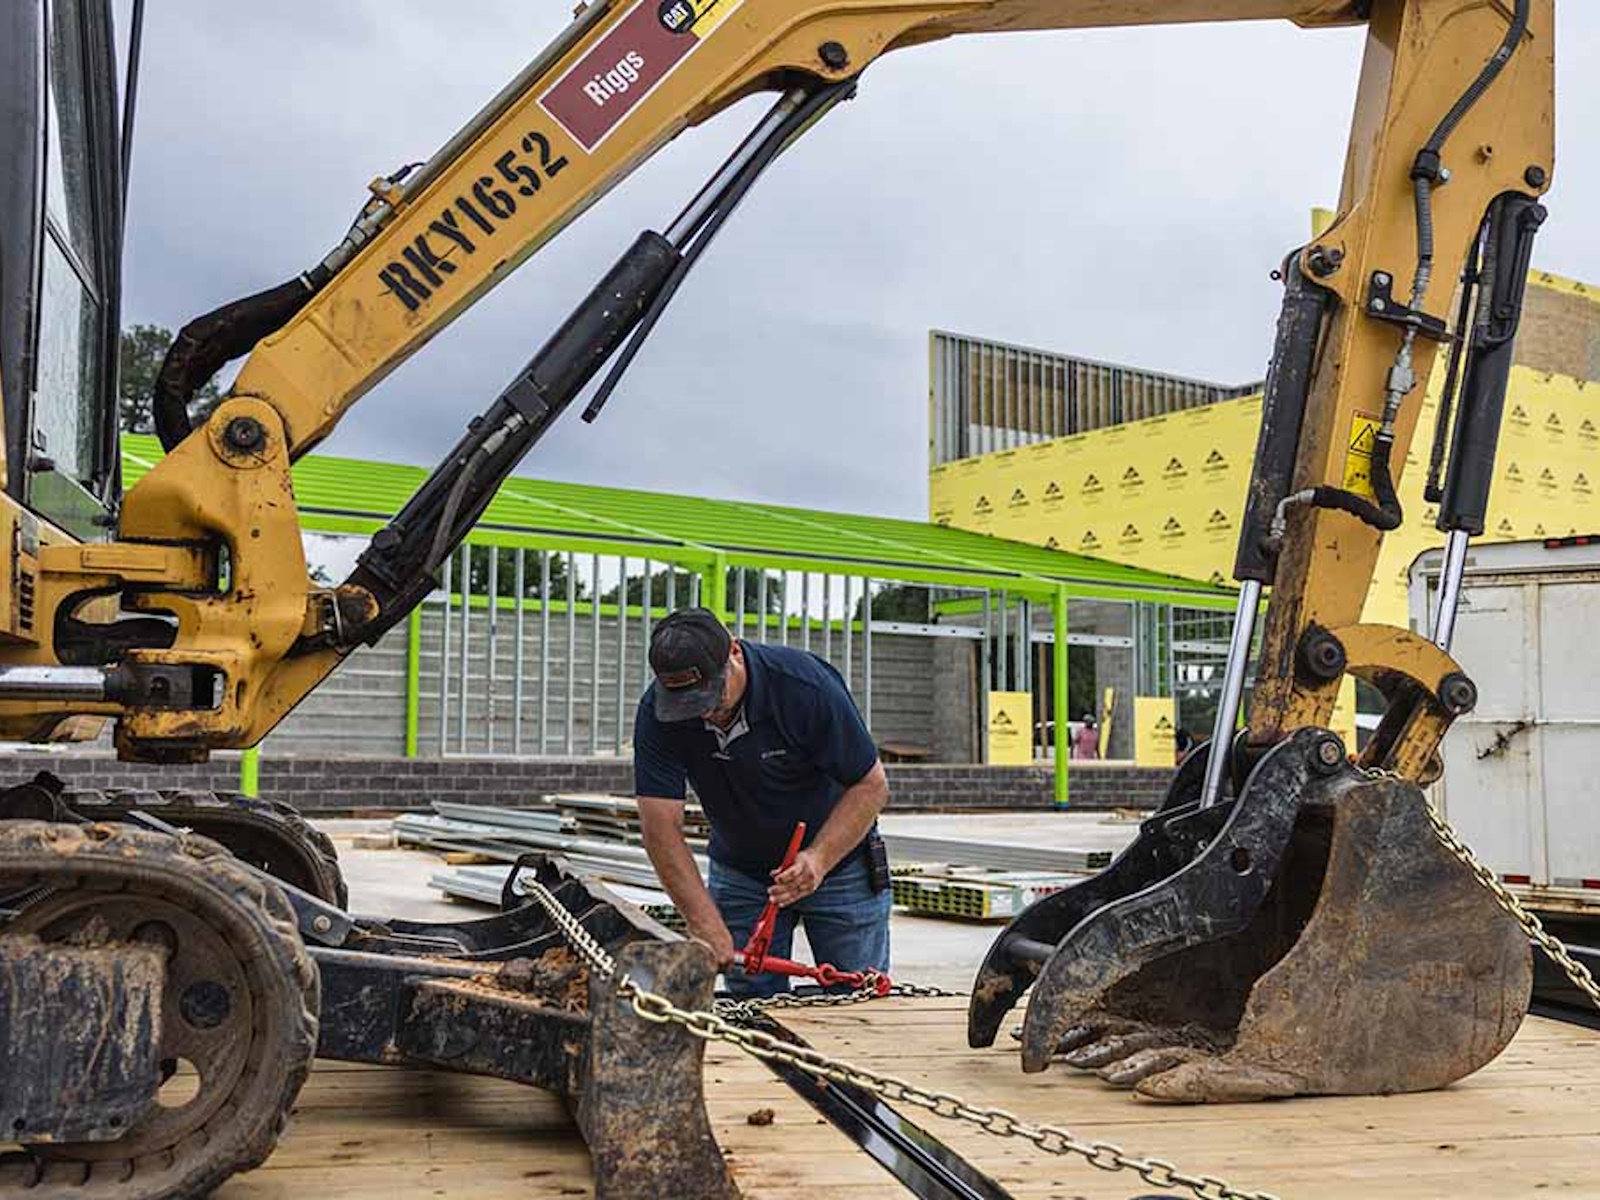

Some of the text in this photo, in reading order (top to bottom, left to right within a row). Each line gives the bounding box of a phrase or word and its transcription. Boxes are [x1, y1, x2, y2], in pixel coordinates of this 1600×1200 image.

[663, 2, 689, 29] CAT
[583, 51, 644, 106] Riggs
[379, 132, 569, 311] RKY1652
